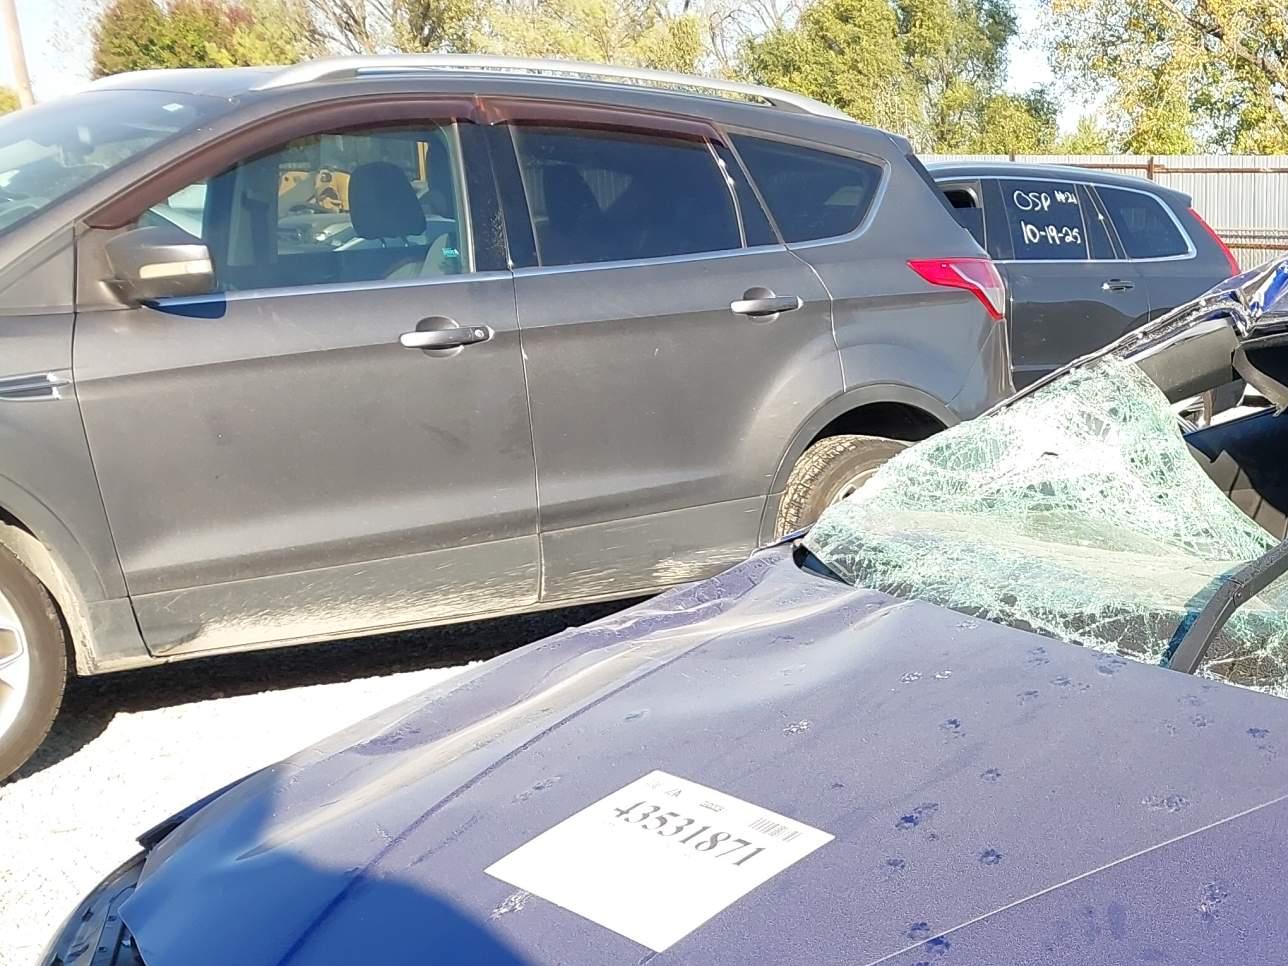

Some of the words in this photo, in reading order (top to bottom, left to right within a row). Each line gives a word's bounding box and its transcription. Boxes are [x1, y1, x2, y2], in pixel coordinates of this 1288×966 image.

[1013, 190, 1051, 212] OSP
[1021, 220, 1081, 245] 10-19-25
[613, 800, 767, 867] 43531871
